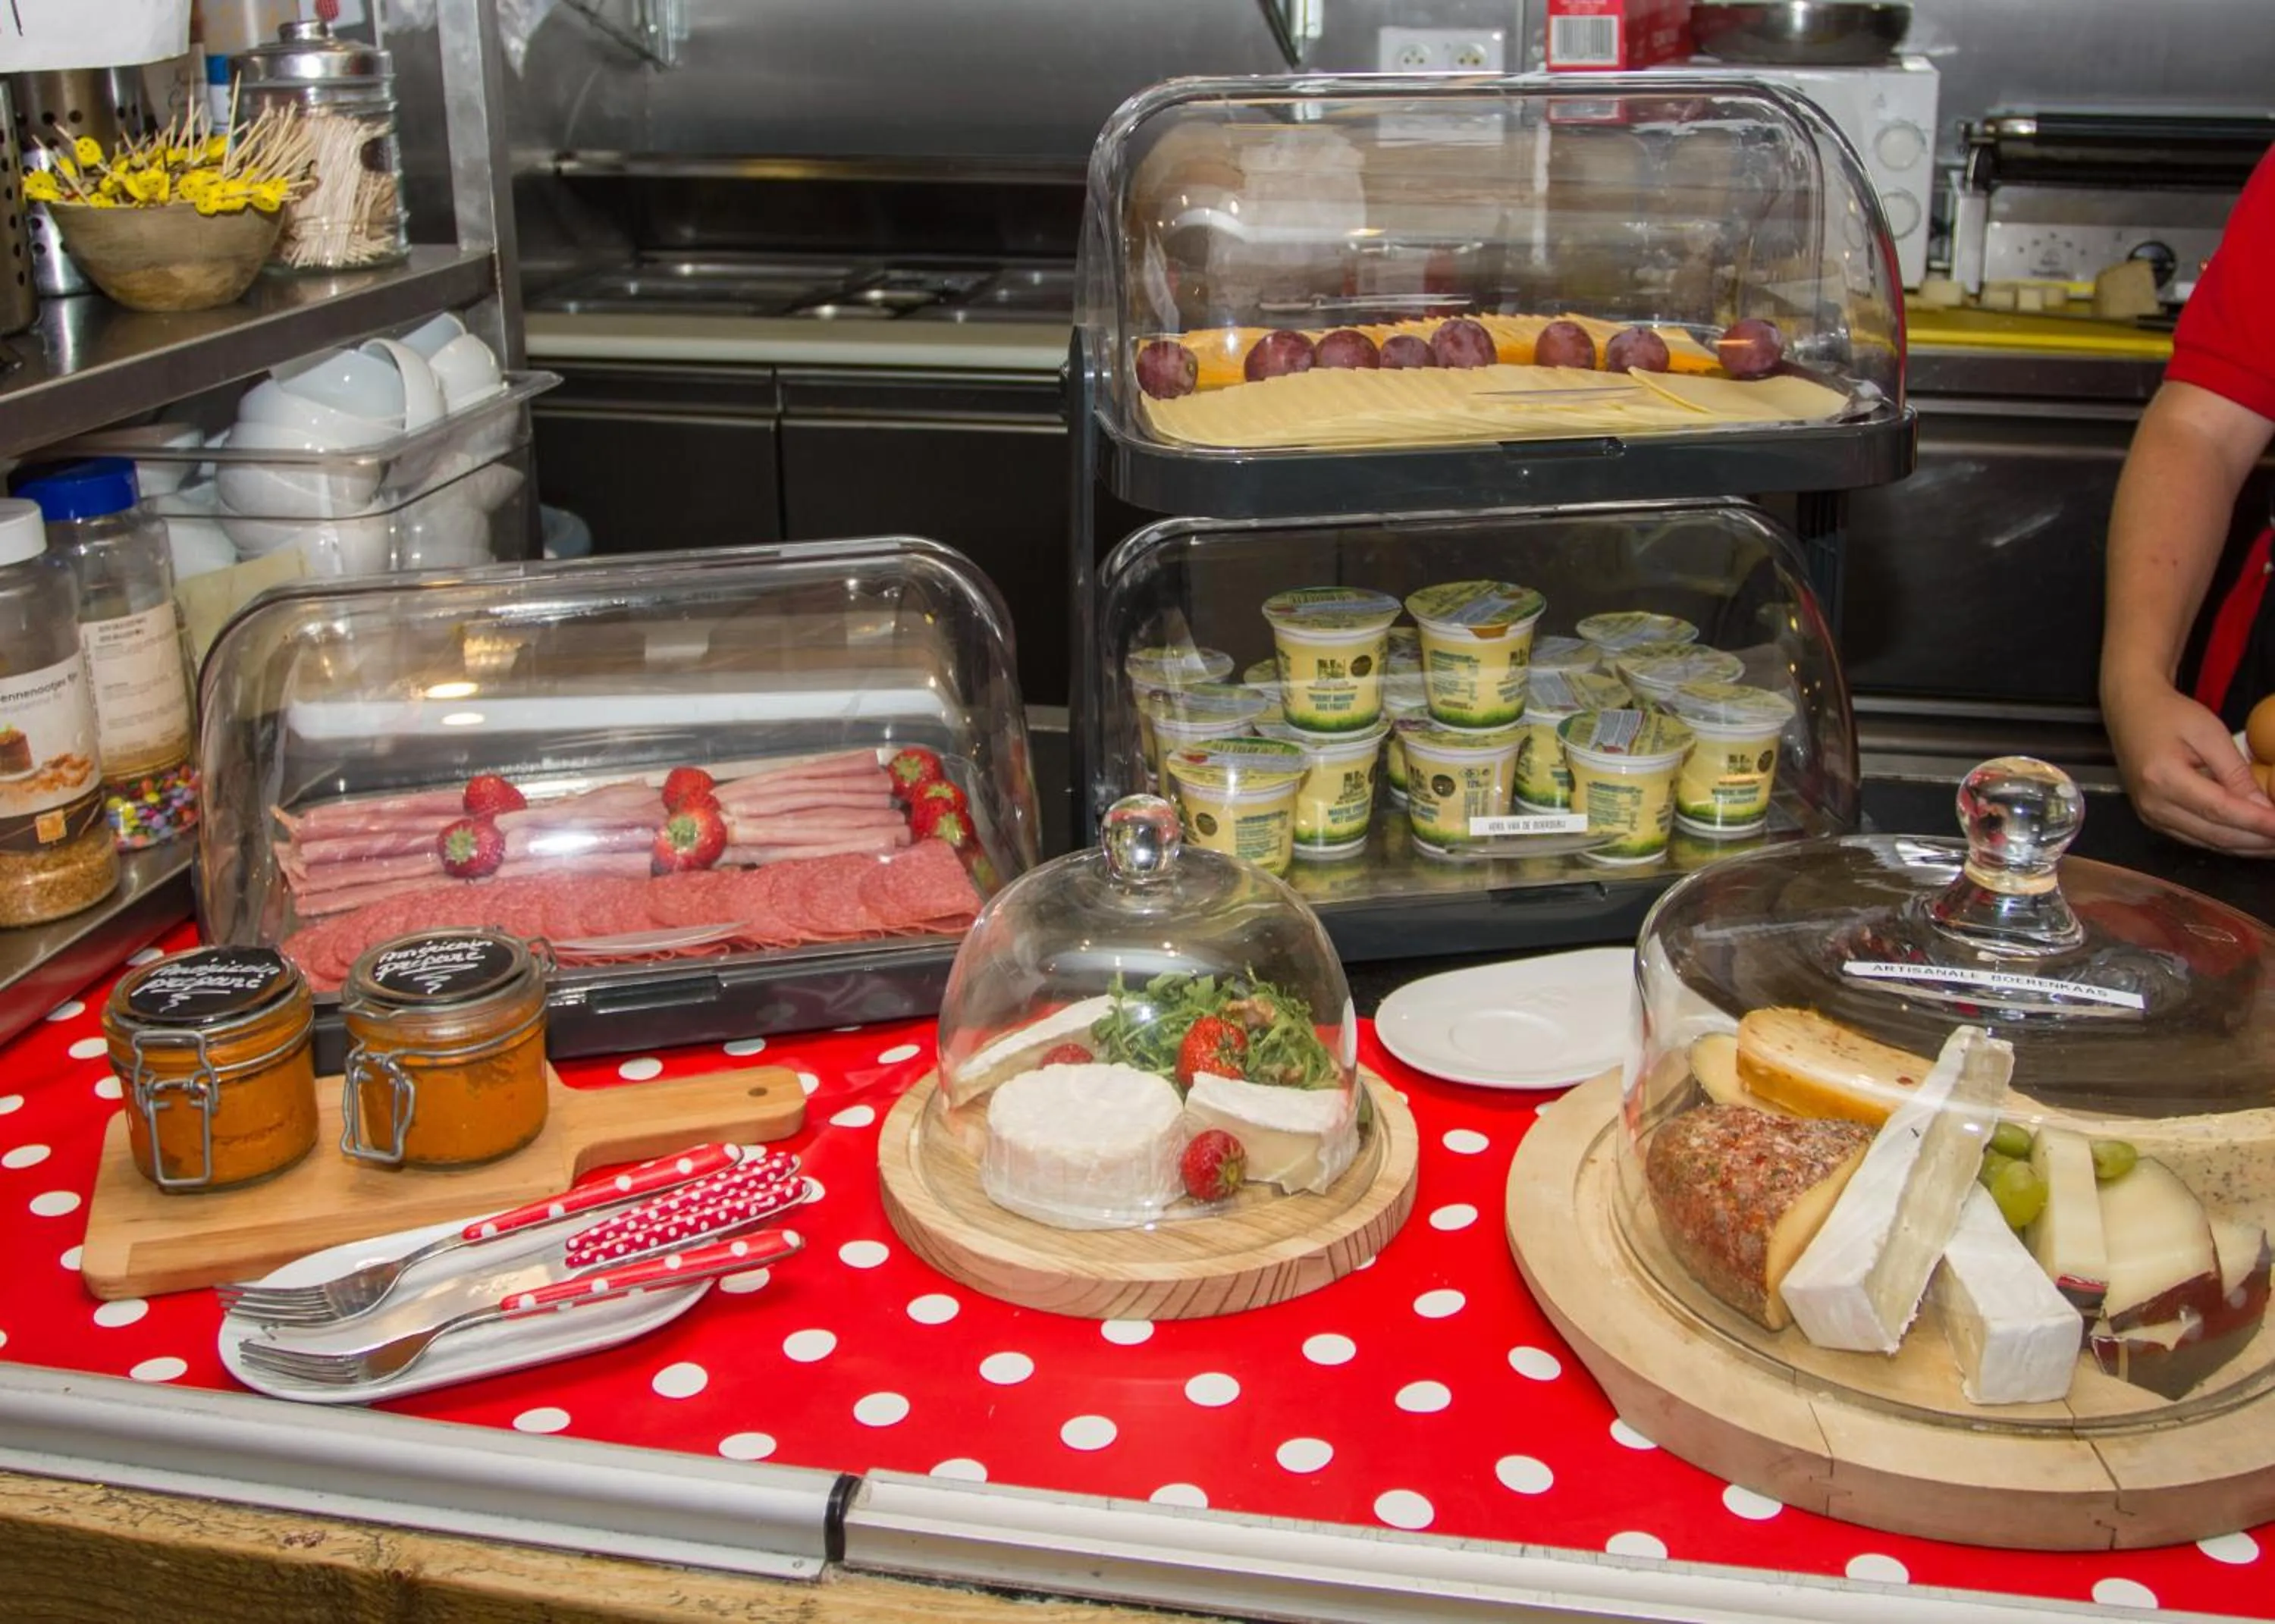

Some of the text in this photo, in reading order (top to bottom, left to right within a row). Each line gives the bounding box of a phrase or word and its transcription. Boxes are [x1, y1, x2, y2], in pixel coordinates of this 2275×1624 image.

[1522, 820, 1530, 829] DE
[1873, 964, 2108, 997] ARTISANALE BOERENKAAS
